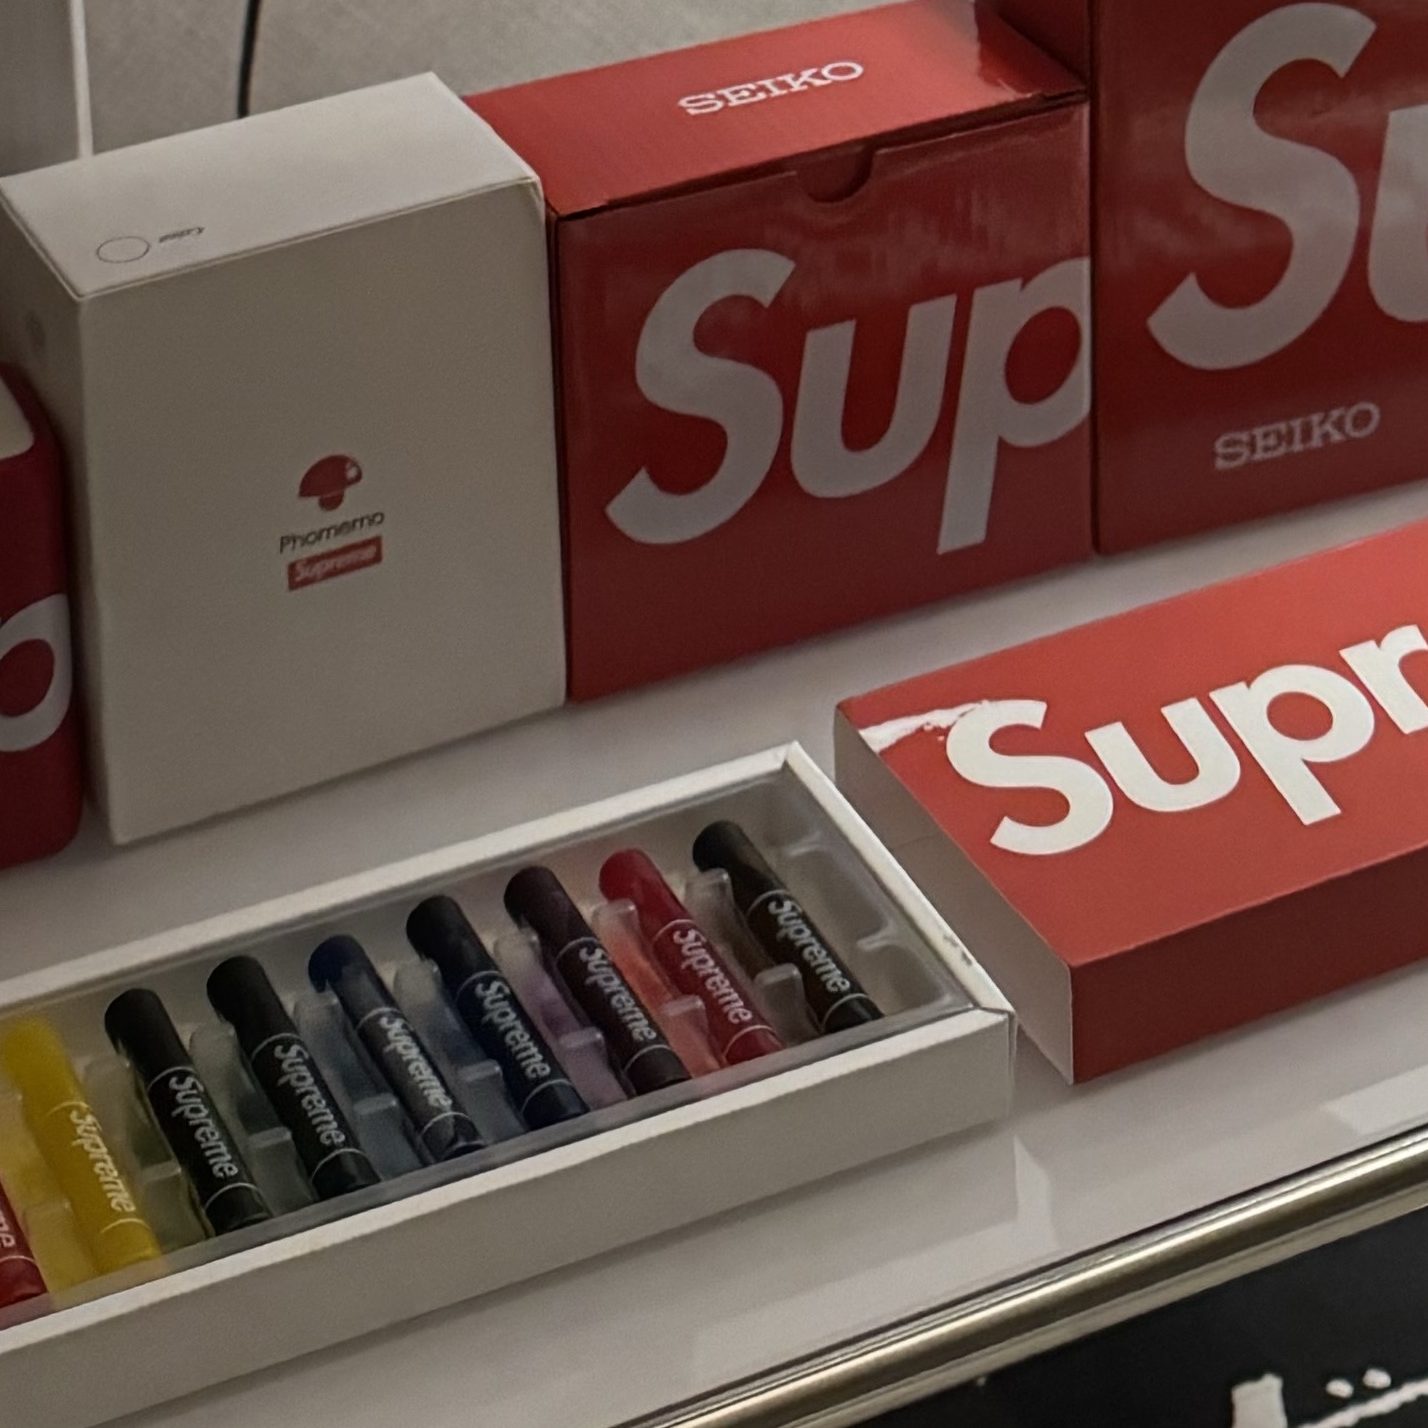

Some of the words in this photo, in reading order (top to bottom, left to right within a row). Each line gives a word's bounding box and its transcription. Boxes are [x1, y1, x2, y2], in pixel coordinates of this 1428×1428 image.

[677, 60, 865, 116] SEIKO
[604, 248, 1091, 555] Sup
[1213, 402, 1380, 470] SEIKO
[280, 512, 384, 554] Phomemo
[579, 945, 657, 1042] Supreme
[673, 928, 753, 1024] Supreme
[768, 898, 851, 993] Supreme
[379, 1015, 453, 1110] Supreme
[475, 979, 551, 1081] Supreme
[168, 1075, 239, 1179] Supreme
[274, 1044, 346, 1146] Supreme
[70, 1108, 136, 1214] Supreme
